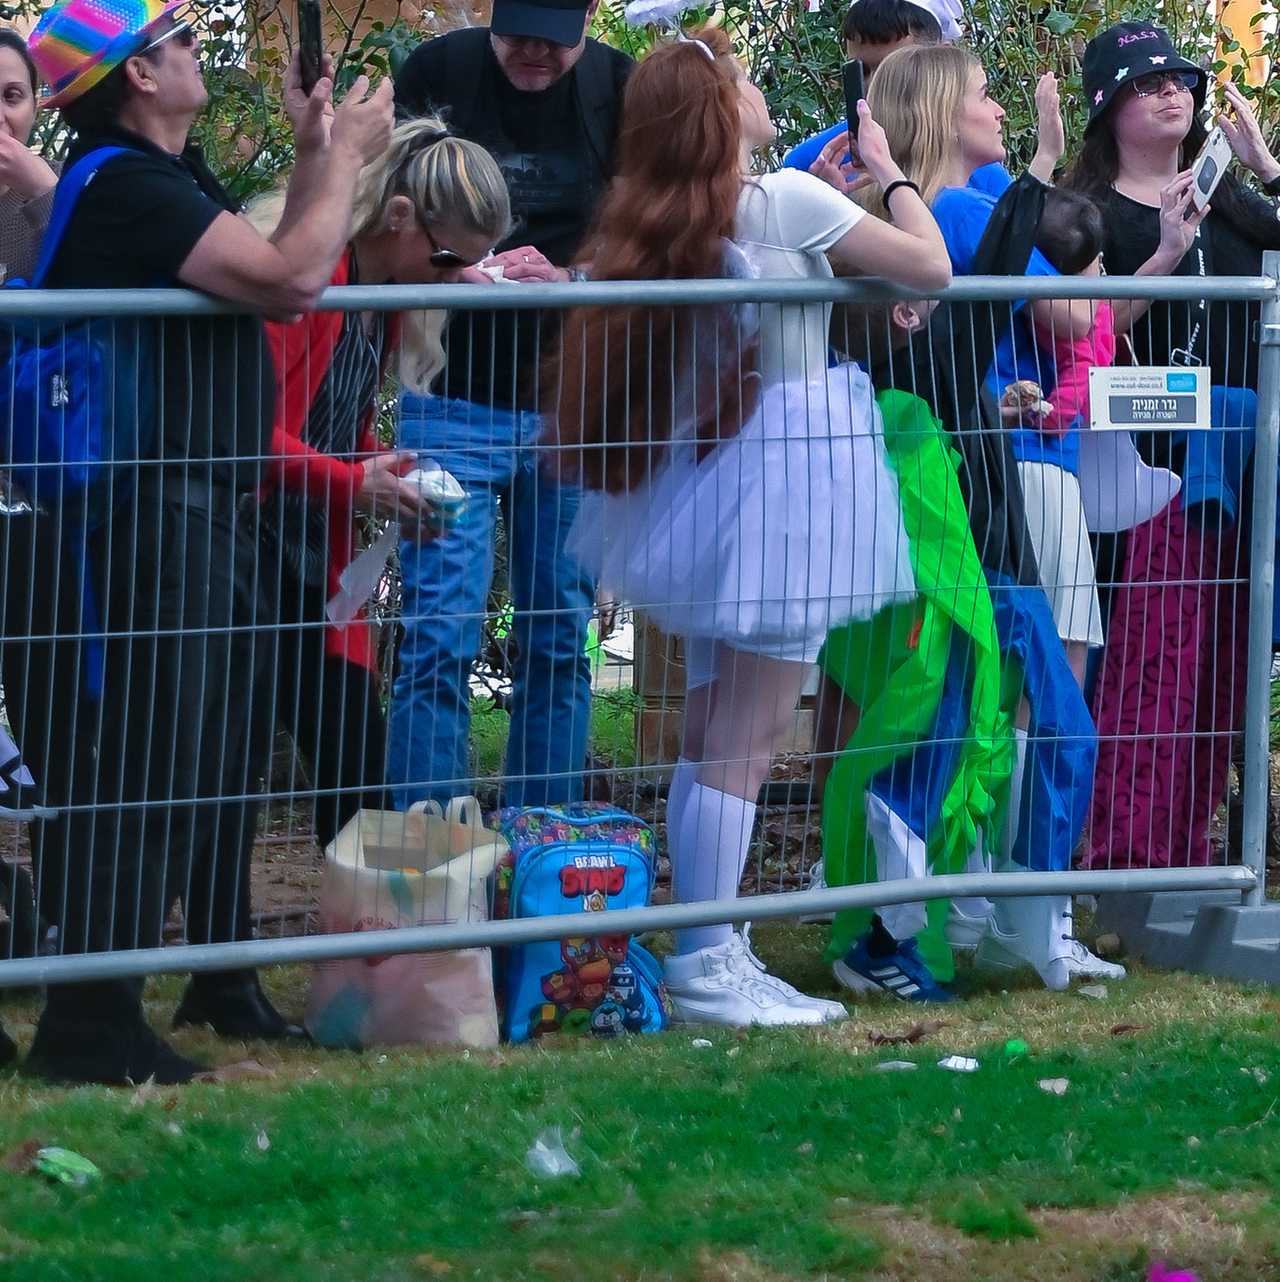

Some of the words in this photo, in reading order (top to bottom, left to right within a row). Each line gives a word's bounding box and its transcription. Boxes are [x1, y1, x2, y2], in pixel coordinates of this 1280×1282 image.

[1117, 30, 1159, 48] NASA
[1132, 399, 1159, 411] זמנית
[1161, 399, 1177, 411] גדר
[574, 855, 616, 869] BRAWL
